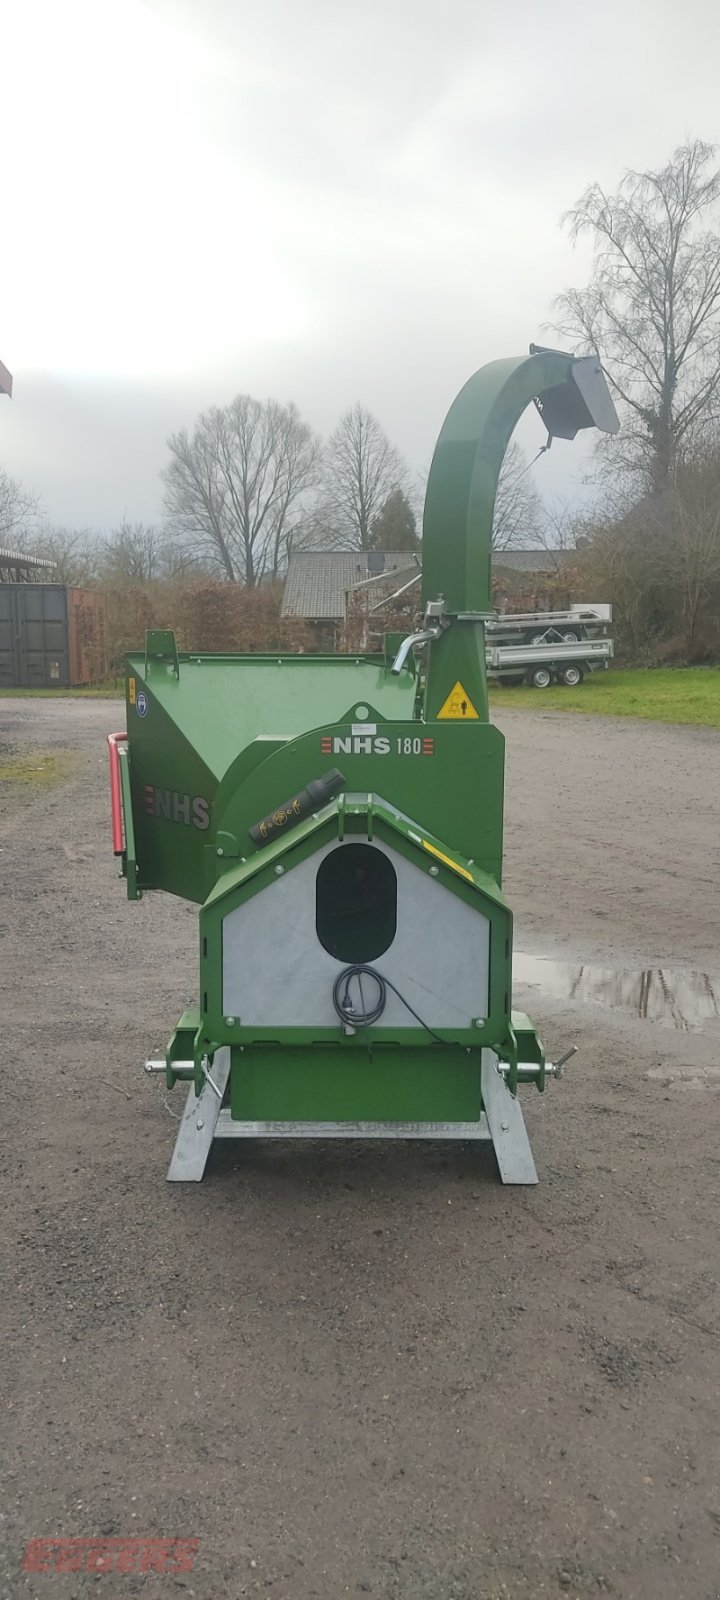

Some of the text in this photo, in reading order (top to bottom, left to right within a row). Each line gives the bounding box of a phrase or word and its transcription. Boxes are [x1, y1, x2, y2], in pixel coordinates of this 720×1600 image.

[333, 736, 422, 755] NHS 180
[153, 787, 210, 831] NHS
